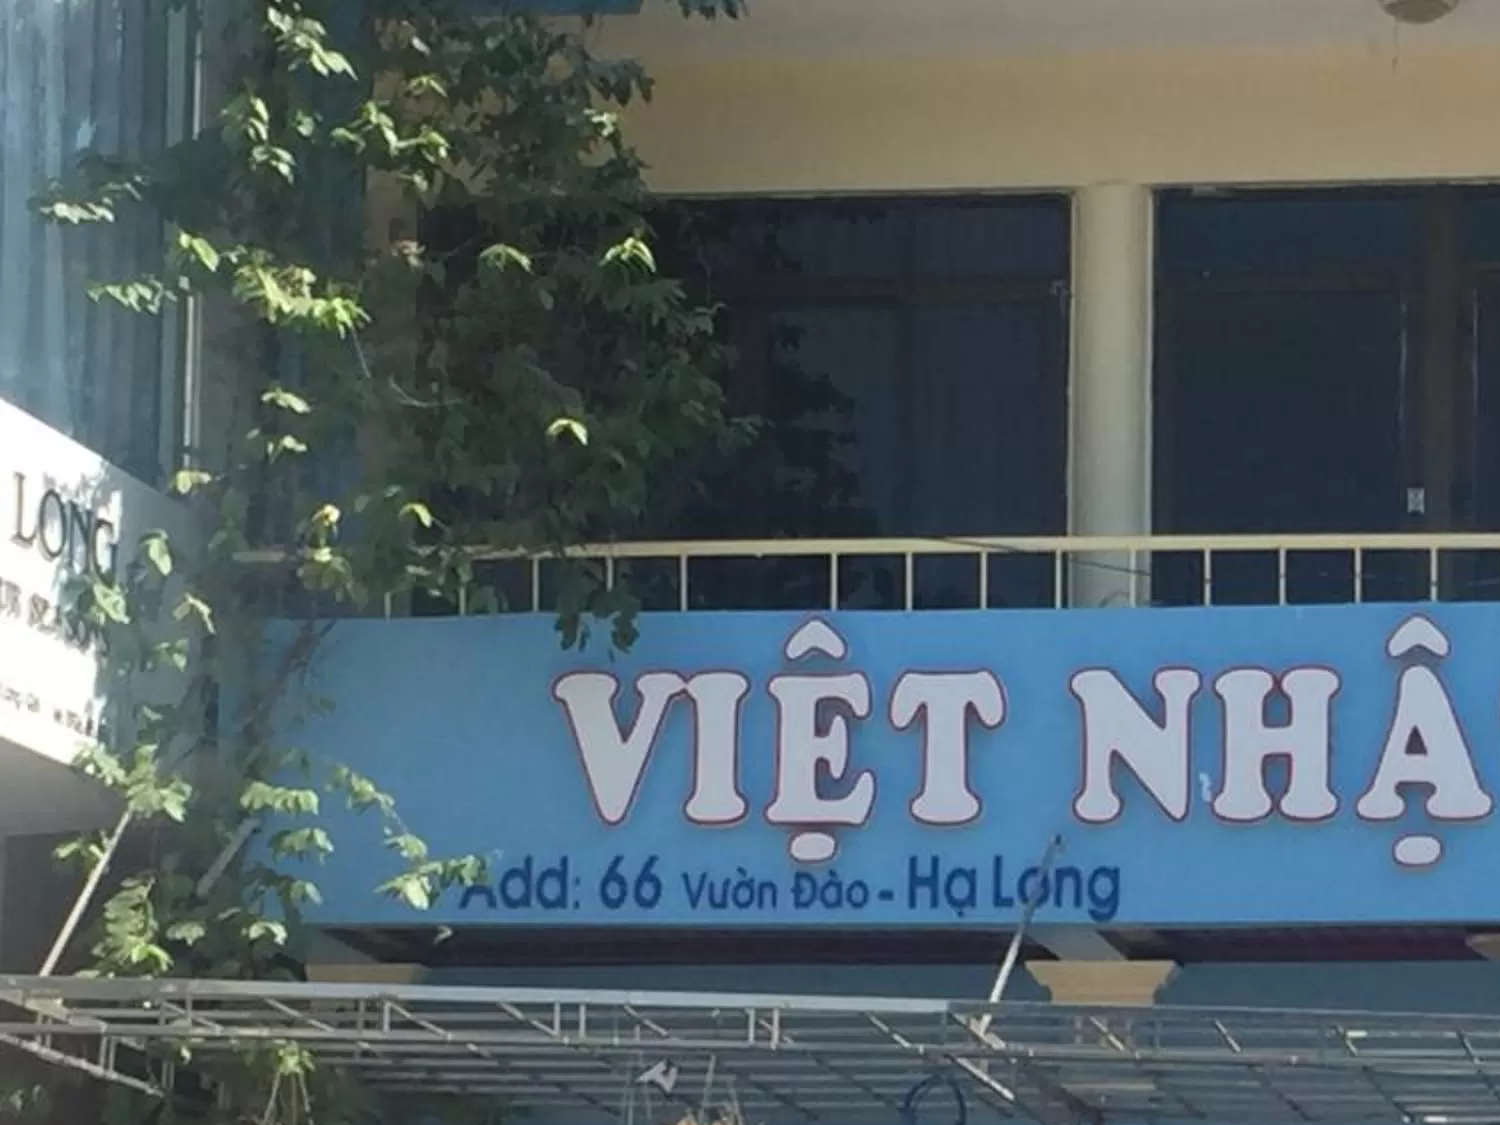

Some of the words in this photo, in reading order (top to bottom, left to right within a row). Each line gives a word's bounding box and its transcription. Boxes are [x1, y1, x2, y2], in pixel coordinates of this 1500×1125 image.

[11, 471, 118, 581] LONG
[552, 617, 1005, 862] VIỆT
[601, 855, 662, 910] 66
[682, 866, 777, 909] Vườn
[908, 856, 977, 917] Hạ
[993, 855, 1120, 922] Long
